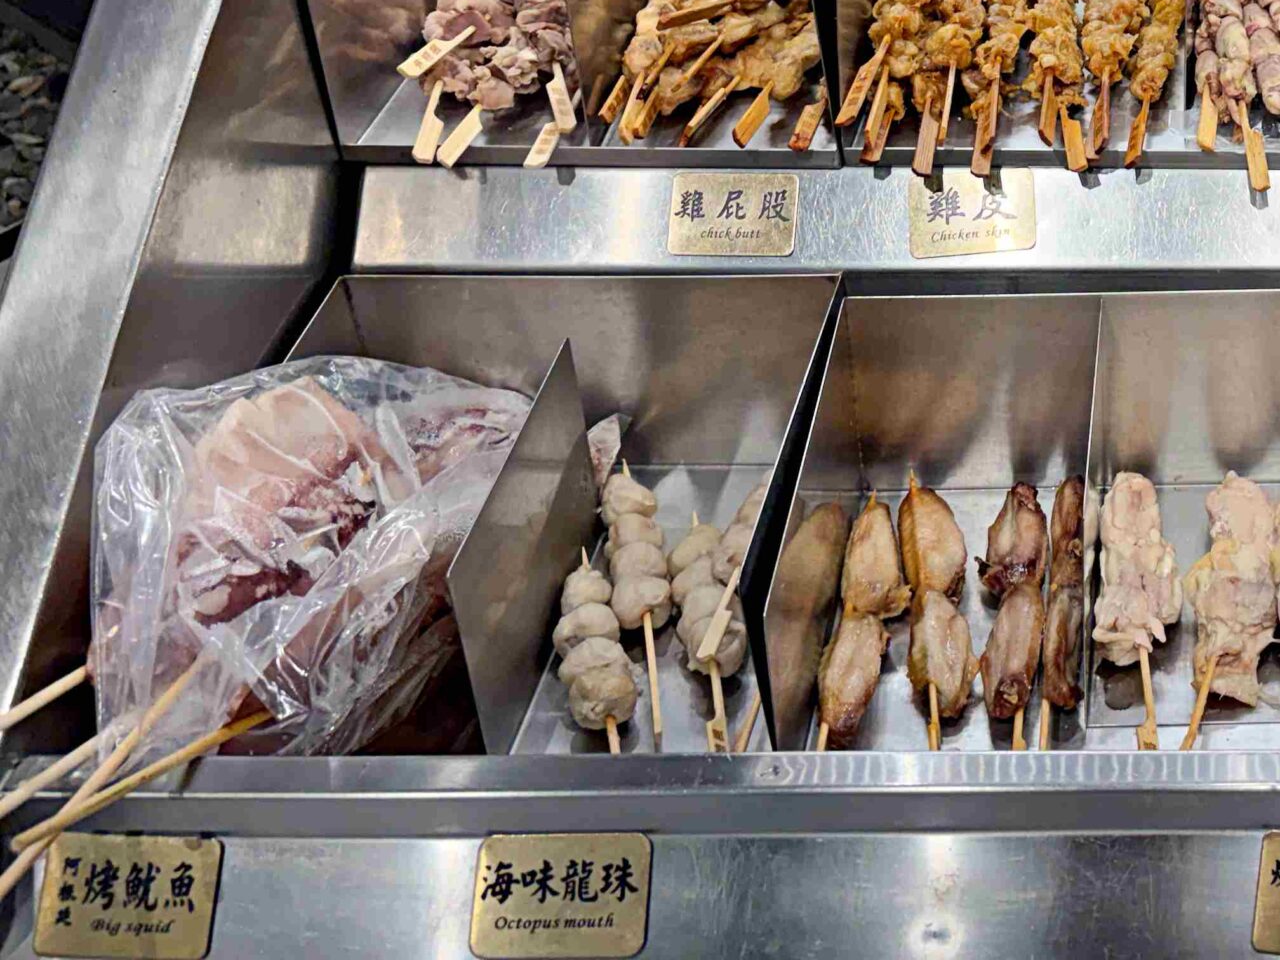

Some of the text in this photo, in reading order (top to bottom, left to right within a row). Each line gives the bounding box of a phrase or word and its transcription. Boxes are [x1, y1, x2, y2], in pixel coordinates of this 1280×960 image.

[674, 189, 790, 222] 雞屁股
[926, 187, 1018, 225] 雞皮
[700, 227, 761, 241] chick butt
[931, 228, 980, 243] Chicken
[82, 859, 195, 913] 烤魷魚
[481, 857, 639, 904] 海味龍珠
[91, 918, 175, 937] Big squid
[494, 912, 615, 934] Octopus mouth
